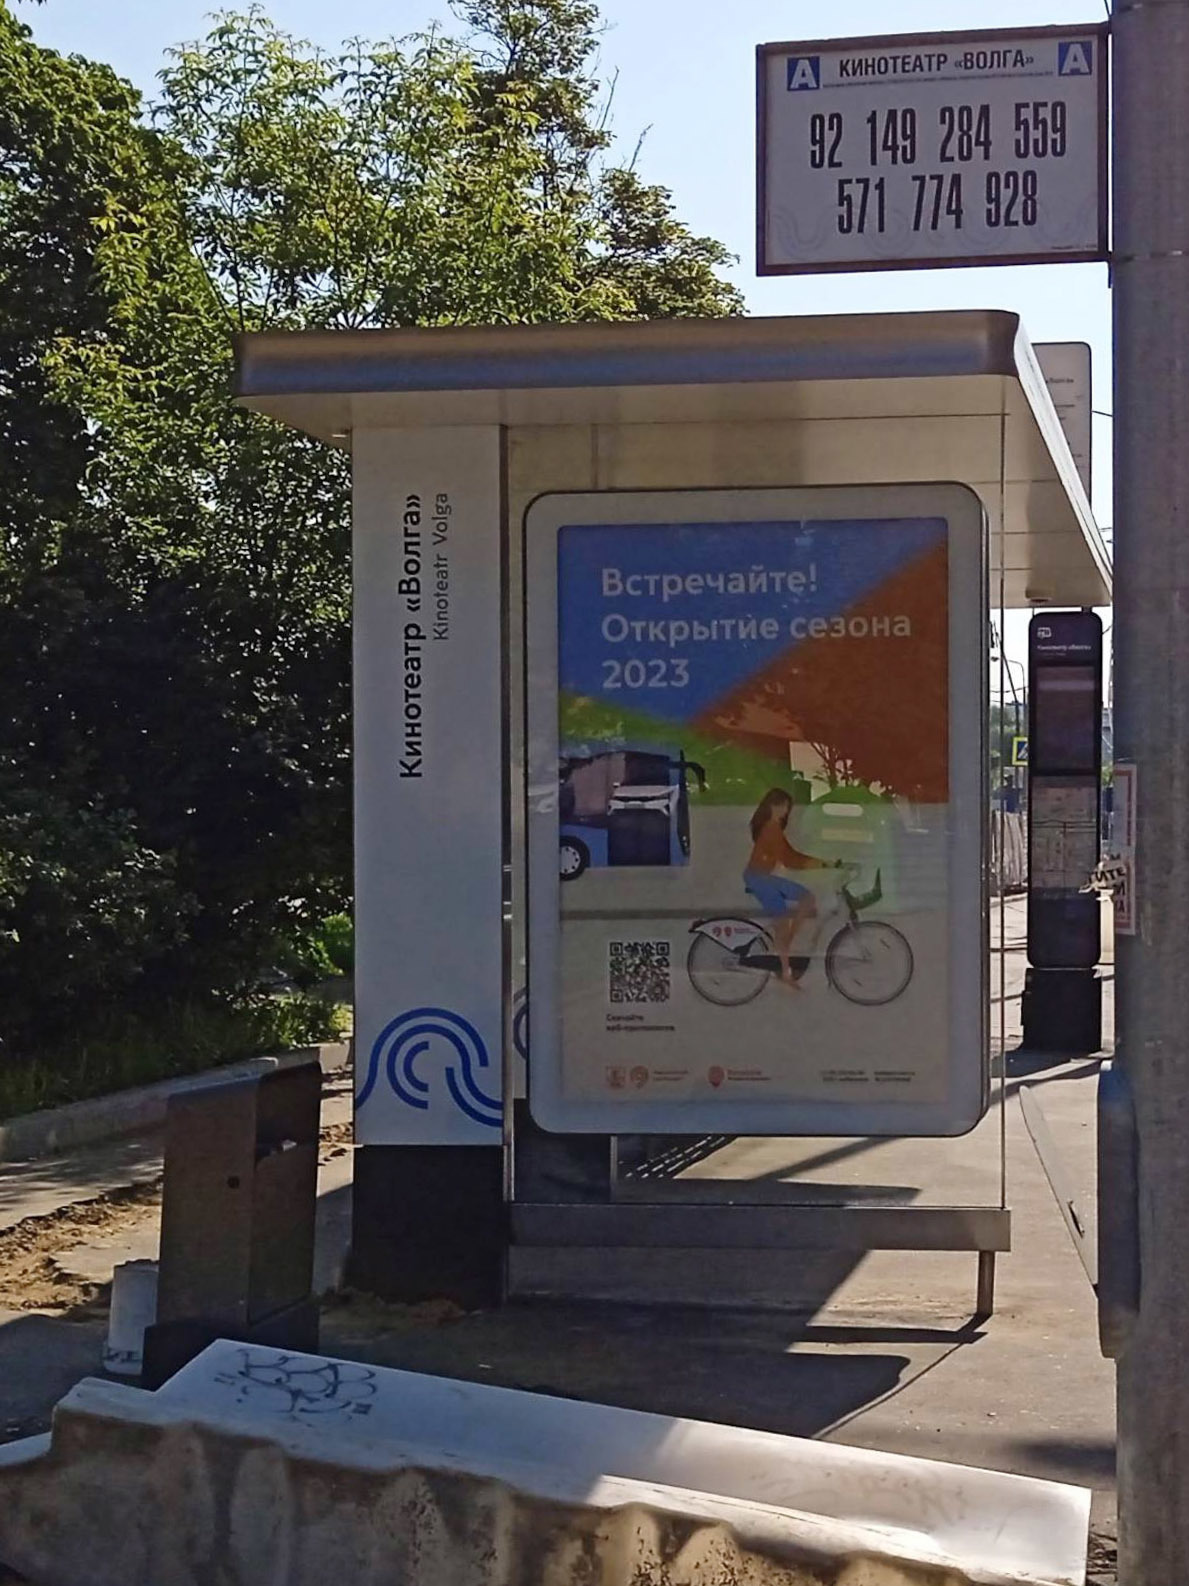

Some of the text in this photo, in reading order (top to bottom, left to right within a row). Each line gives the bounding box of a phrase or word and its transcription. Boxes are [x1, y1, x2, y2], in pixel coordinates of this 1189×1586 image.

[838, 48, 1035, 78] КИНОТЕАТР «ВОЛГА»
[809, 100, 1067, 169] 92 149 284 559
[837, 169, 1039, 235] 571 774 928
[433, 492, 453, 641] Kinoteatr Volga
[601, 564, 818, 602] Встречайте!
[398, 493, 426, 779] Кинотеатр «Волга»
[601, 613, 912, 648] Открытие сезона
[601, 658, 690, 690] 2023
